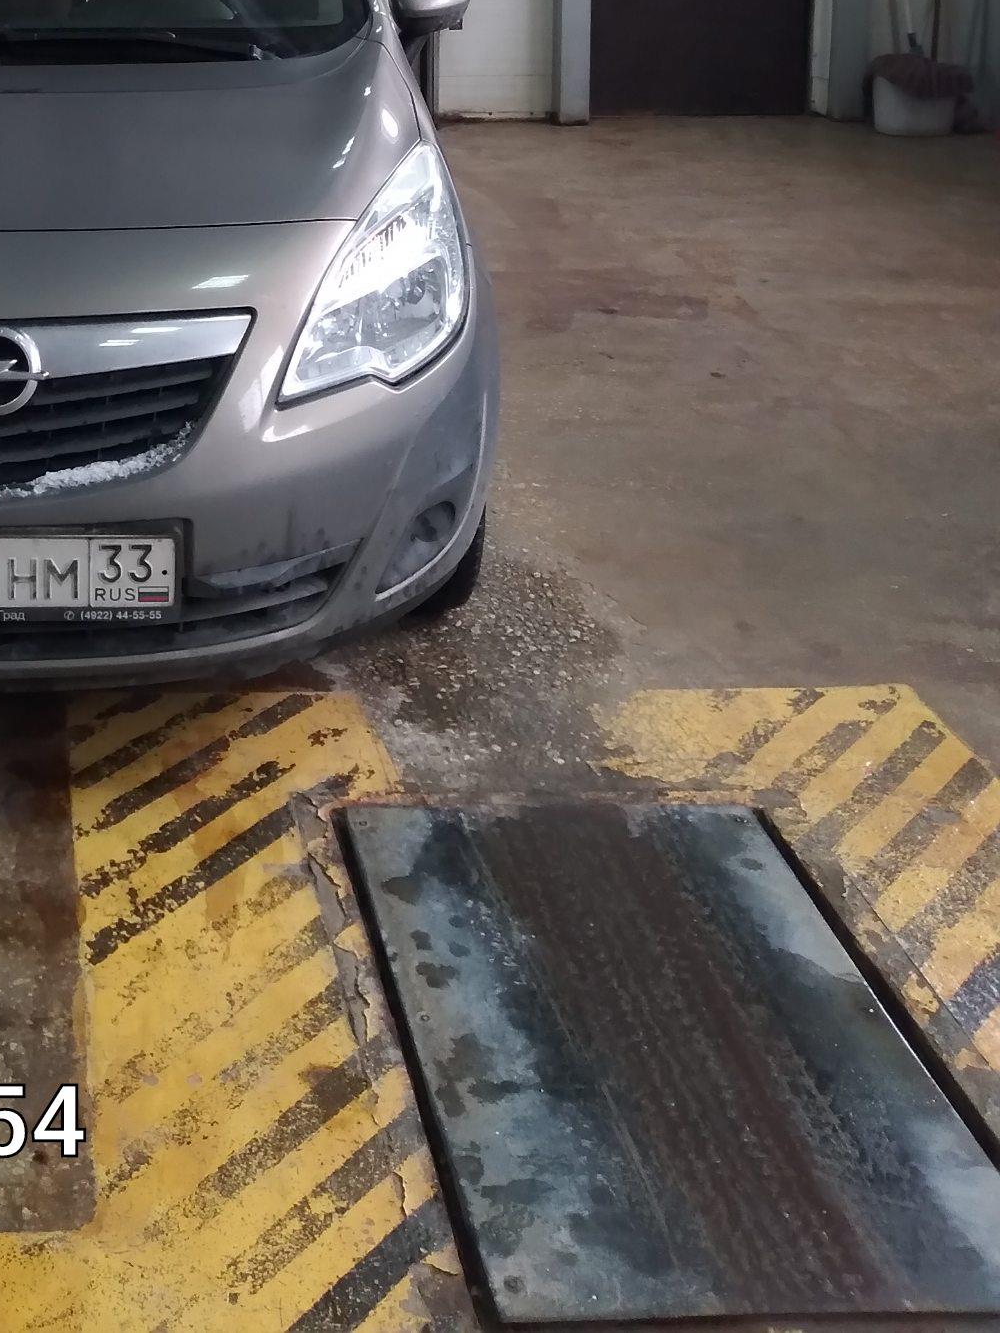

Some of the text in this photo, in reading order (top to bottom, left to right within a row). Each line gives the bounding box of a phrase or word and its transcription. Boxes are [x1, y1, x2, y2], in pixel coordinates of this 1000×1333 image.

[98, 544, 153, 584] 33
[94, 587, 136, 601] RUS
[80, 610, 162, 621] (4922) 44-55-55
